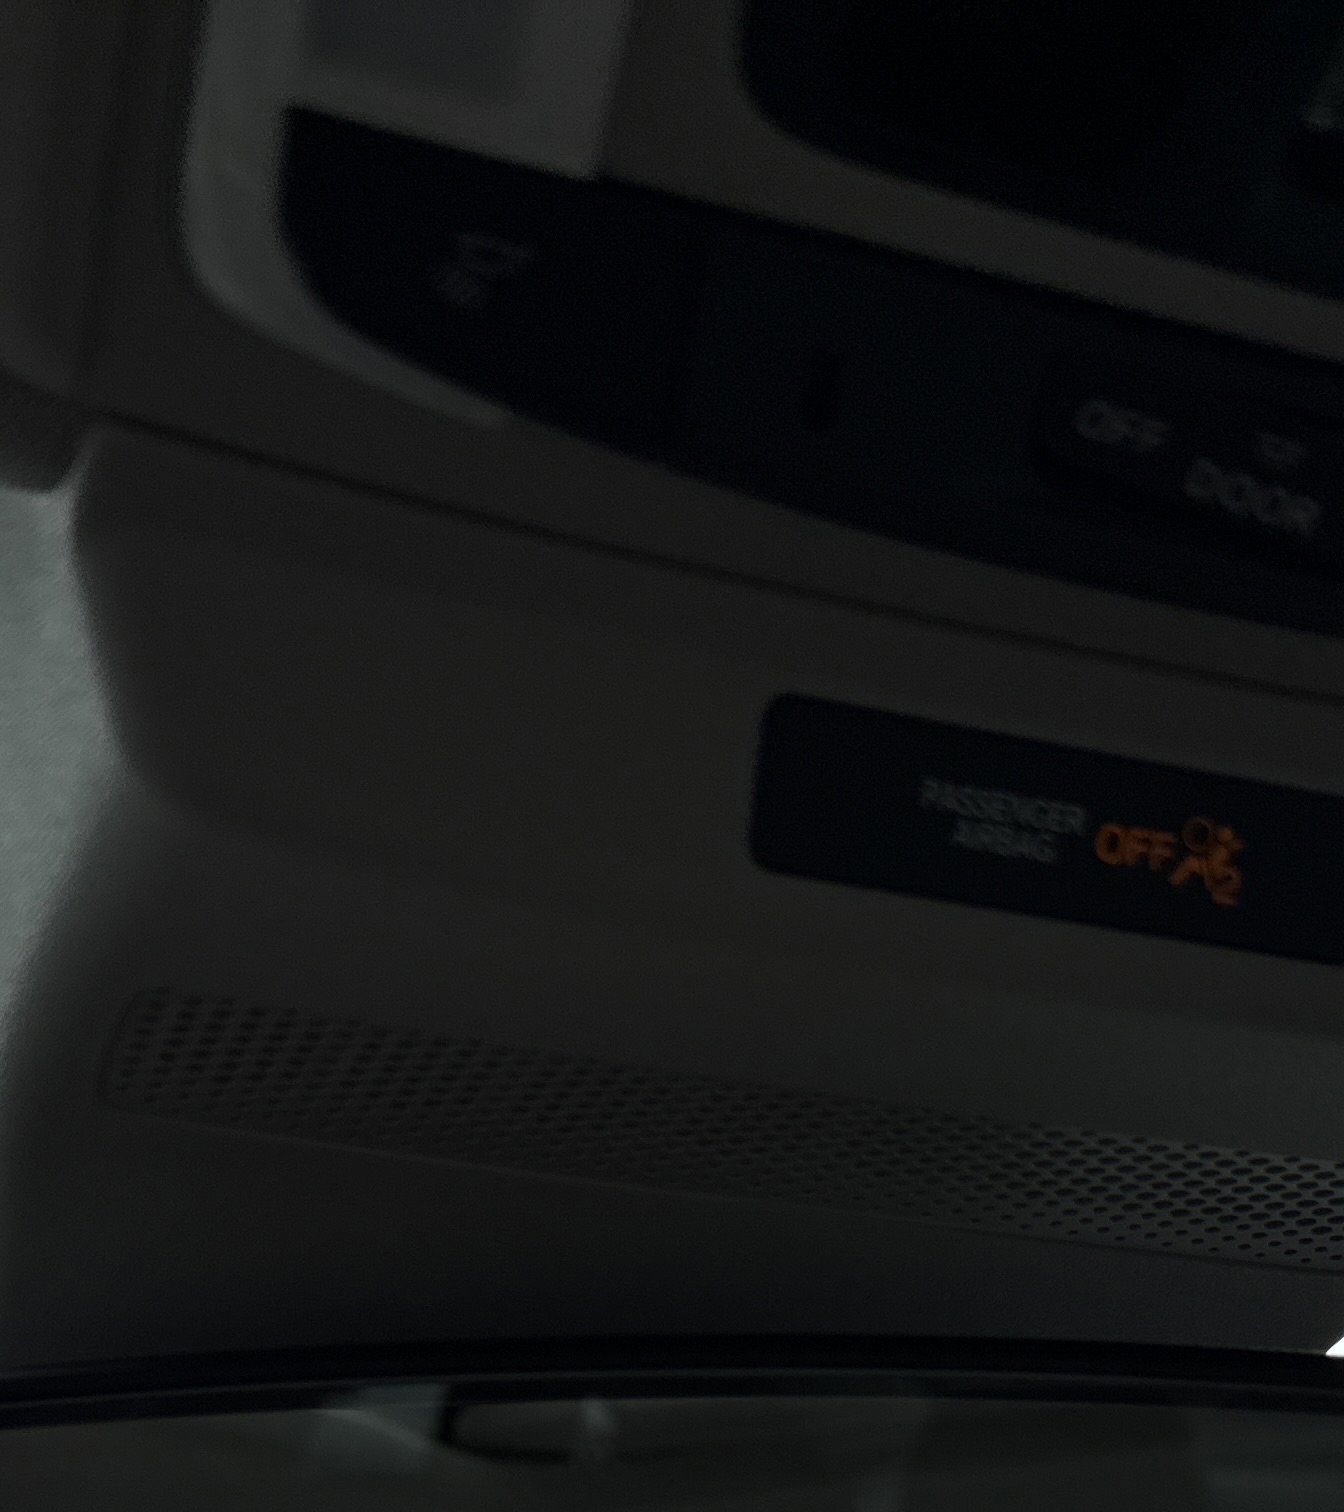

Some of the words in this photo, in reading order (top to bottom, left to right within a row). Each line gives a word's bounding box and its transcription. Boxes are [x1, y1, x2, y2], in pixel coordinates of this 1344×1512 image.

[1073, 401, 1170, 449] OFF
[1184, 457, 1320, 539] DOOR
[919, 778, 1088, 835] PASSENGER
[952, 818, 1058, 864] AIRBAG
[1094, 821, 1175, 871] OFF
